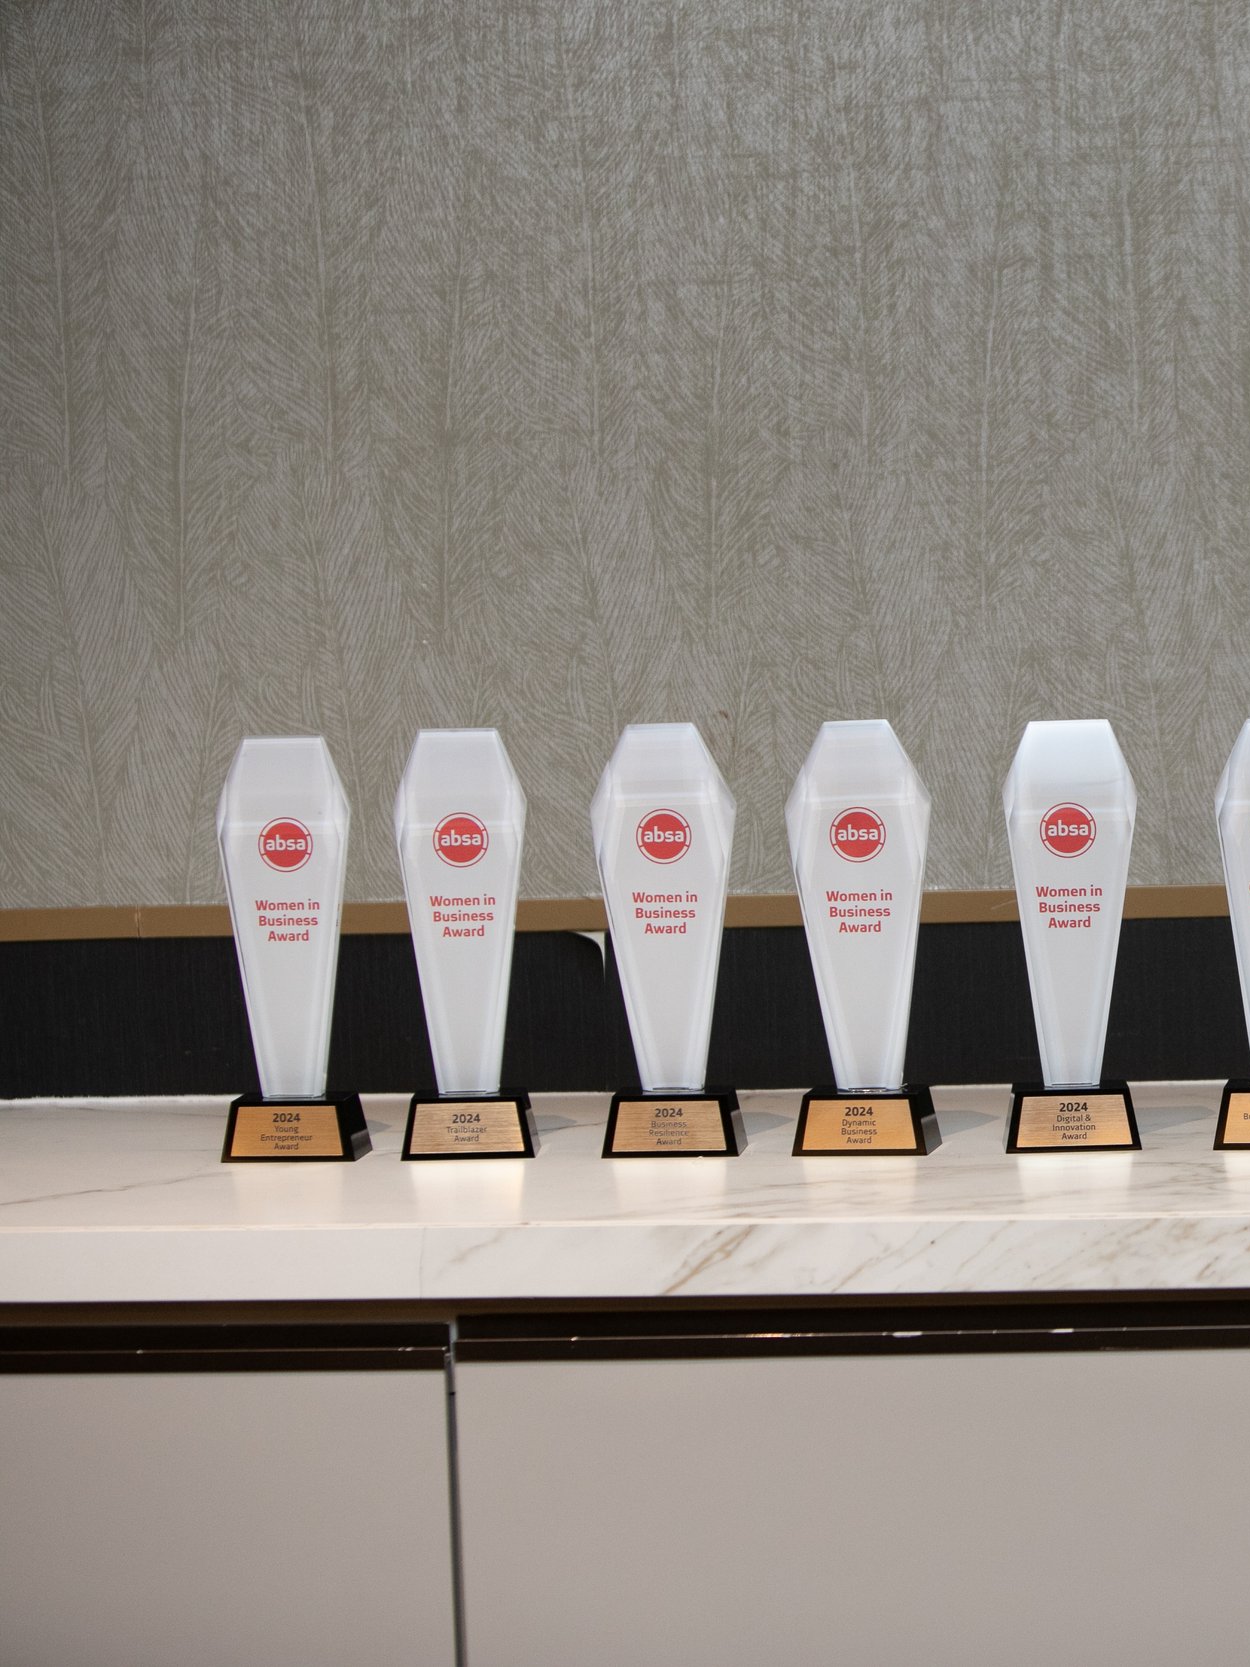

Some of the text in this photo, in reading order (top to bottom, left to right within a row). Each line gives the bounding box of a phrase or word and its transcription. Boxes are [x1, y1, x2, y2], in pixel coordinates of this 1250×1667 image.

[837, 824, 878, 841] absa
[1048, 820, 1088, 836] absa
[440, 830, 480, 846] absa
[643, 826, 684, 843] absa
[266, 835, 306, 851] absa
[826, 891, 892, 903] Women in
[1036, 886, 1103, 898] Women in
[430, 896, 496, 907] Women in
[633, 892, 698, 904] Women in
[256, 900, 320, 911] Women in
[1040, 902, 1100, 914] Business
[433, 911, 493, 923] Business
[634, 908, 695, 919] Business
[829, 906, 891, 919] Business
[258, 916, 318, 927] Business
[839, 921, 881, 933] Award
[1048, 917, 1091, 929] Award
[443, 927, 485, 938] Award
[645, 923, 687, 935] Award
[268, 931, 310, 942] Award
[845, 1106, 873, 1117] 2024
[1059, 1102, 1088, 1112] 2024
[272, 1113, 301, 1123] 2024
[655, 1108, 683, 1118] 2024
[452, 1114, 481, 1124] 2024
[651, 1120, 687, 1128] Business
[842, 1119, 877, 1128] Dynamic
[1056, 1114, 1083, 1124] Digital
[274, 1125, 299, 1134] Young
[841, 1128, 878, 1136] Business
[1052, 1123, 1096, 1131] Innovation
[260, 1134, 312, 1142] Entrepreneur
[846, 1136, 872, 1144] Award
[1061, 1132, 1087, 1140] Award
